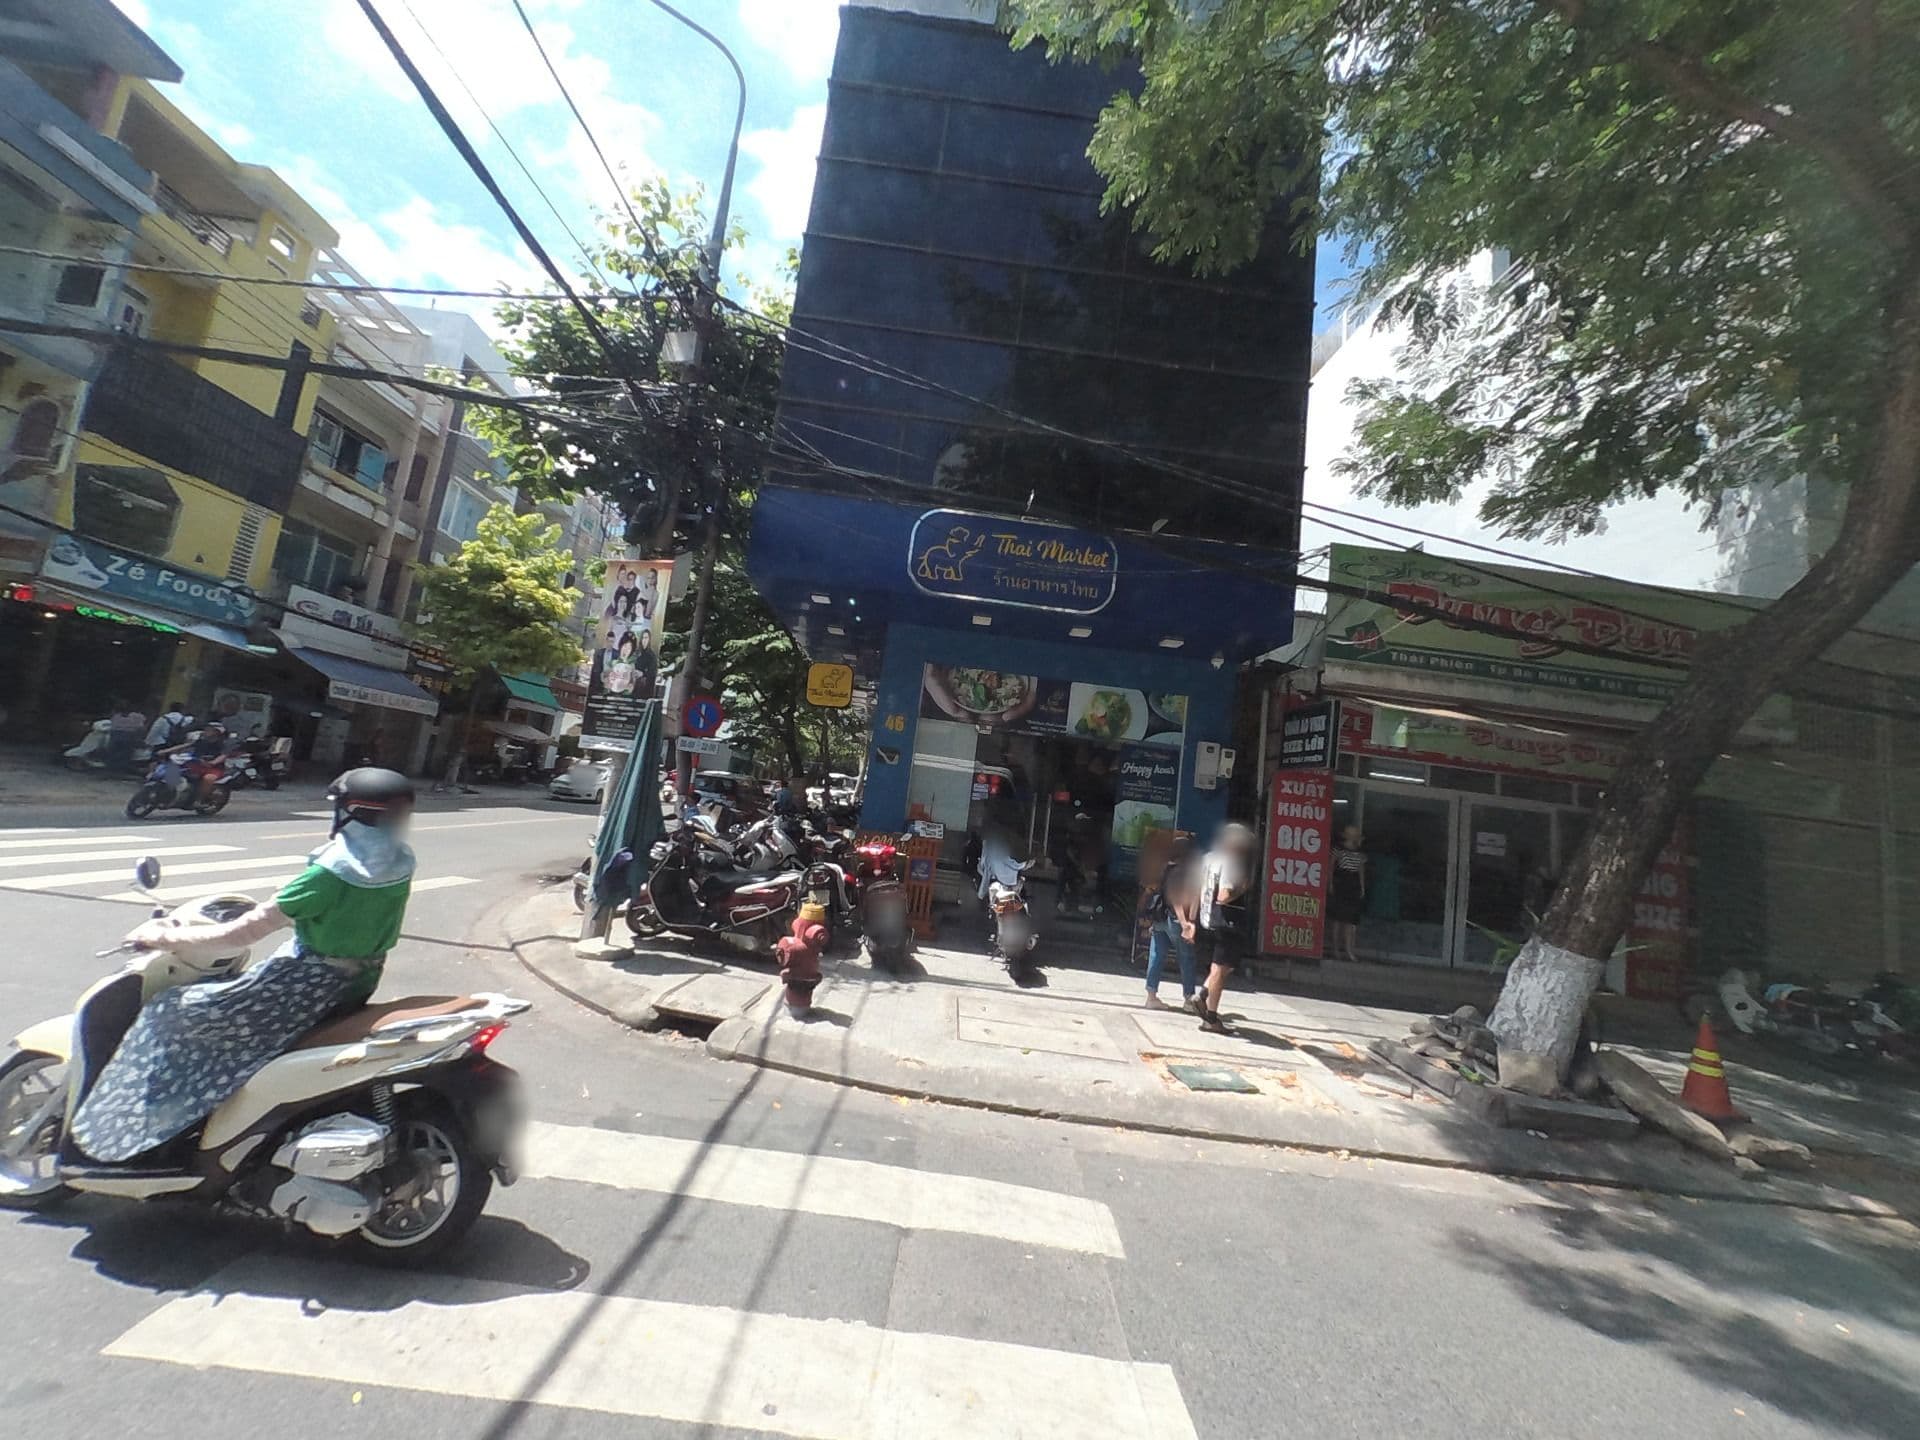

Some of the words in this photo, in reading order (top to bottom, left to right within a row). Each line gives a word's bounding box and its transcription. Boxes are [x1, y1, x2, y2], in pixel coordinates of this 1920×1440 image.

[992, 534, 1033, 557] Thai
[1036, 539, 1109, 568] Market
[105, 554, 145, 581] Zé
[885, 714, 905, 732] 46
[1121, 761, 1152, 779] Happy
[1153, 764, 1175, 776] hour
[1280, 778, 1327, 799] XUẤT
[1277, 798, 1327, 821] KHẨU
[1277, 824, 1322, 854] BIG
[1271, 857, 1322, 888] SIZE
